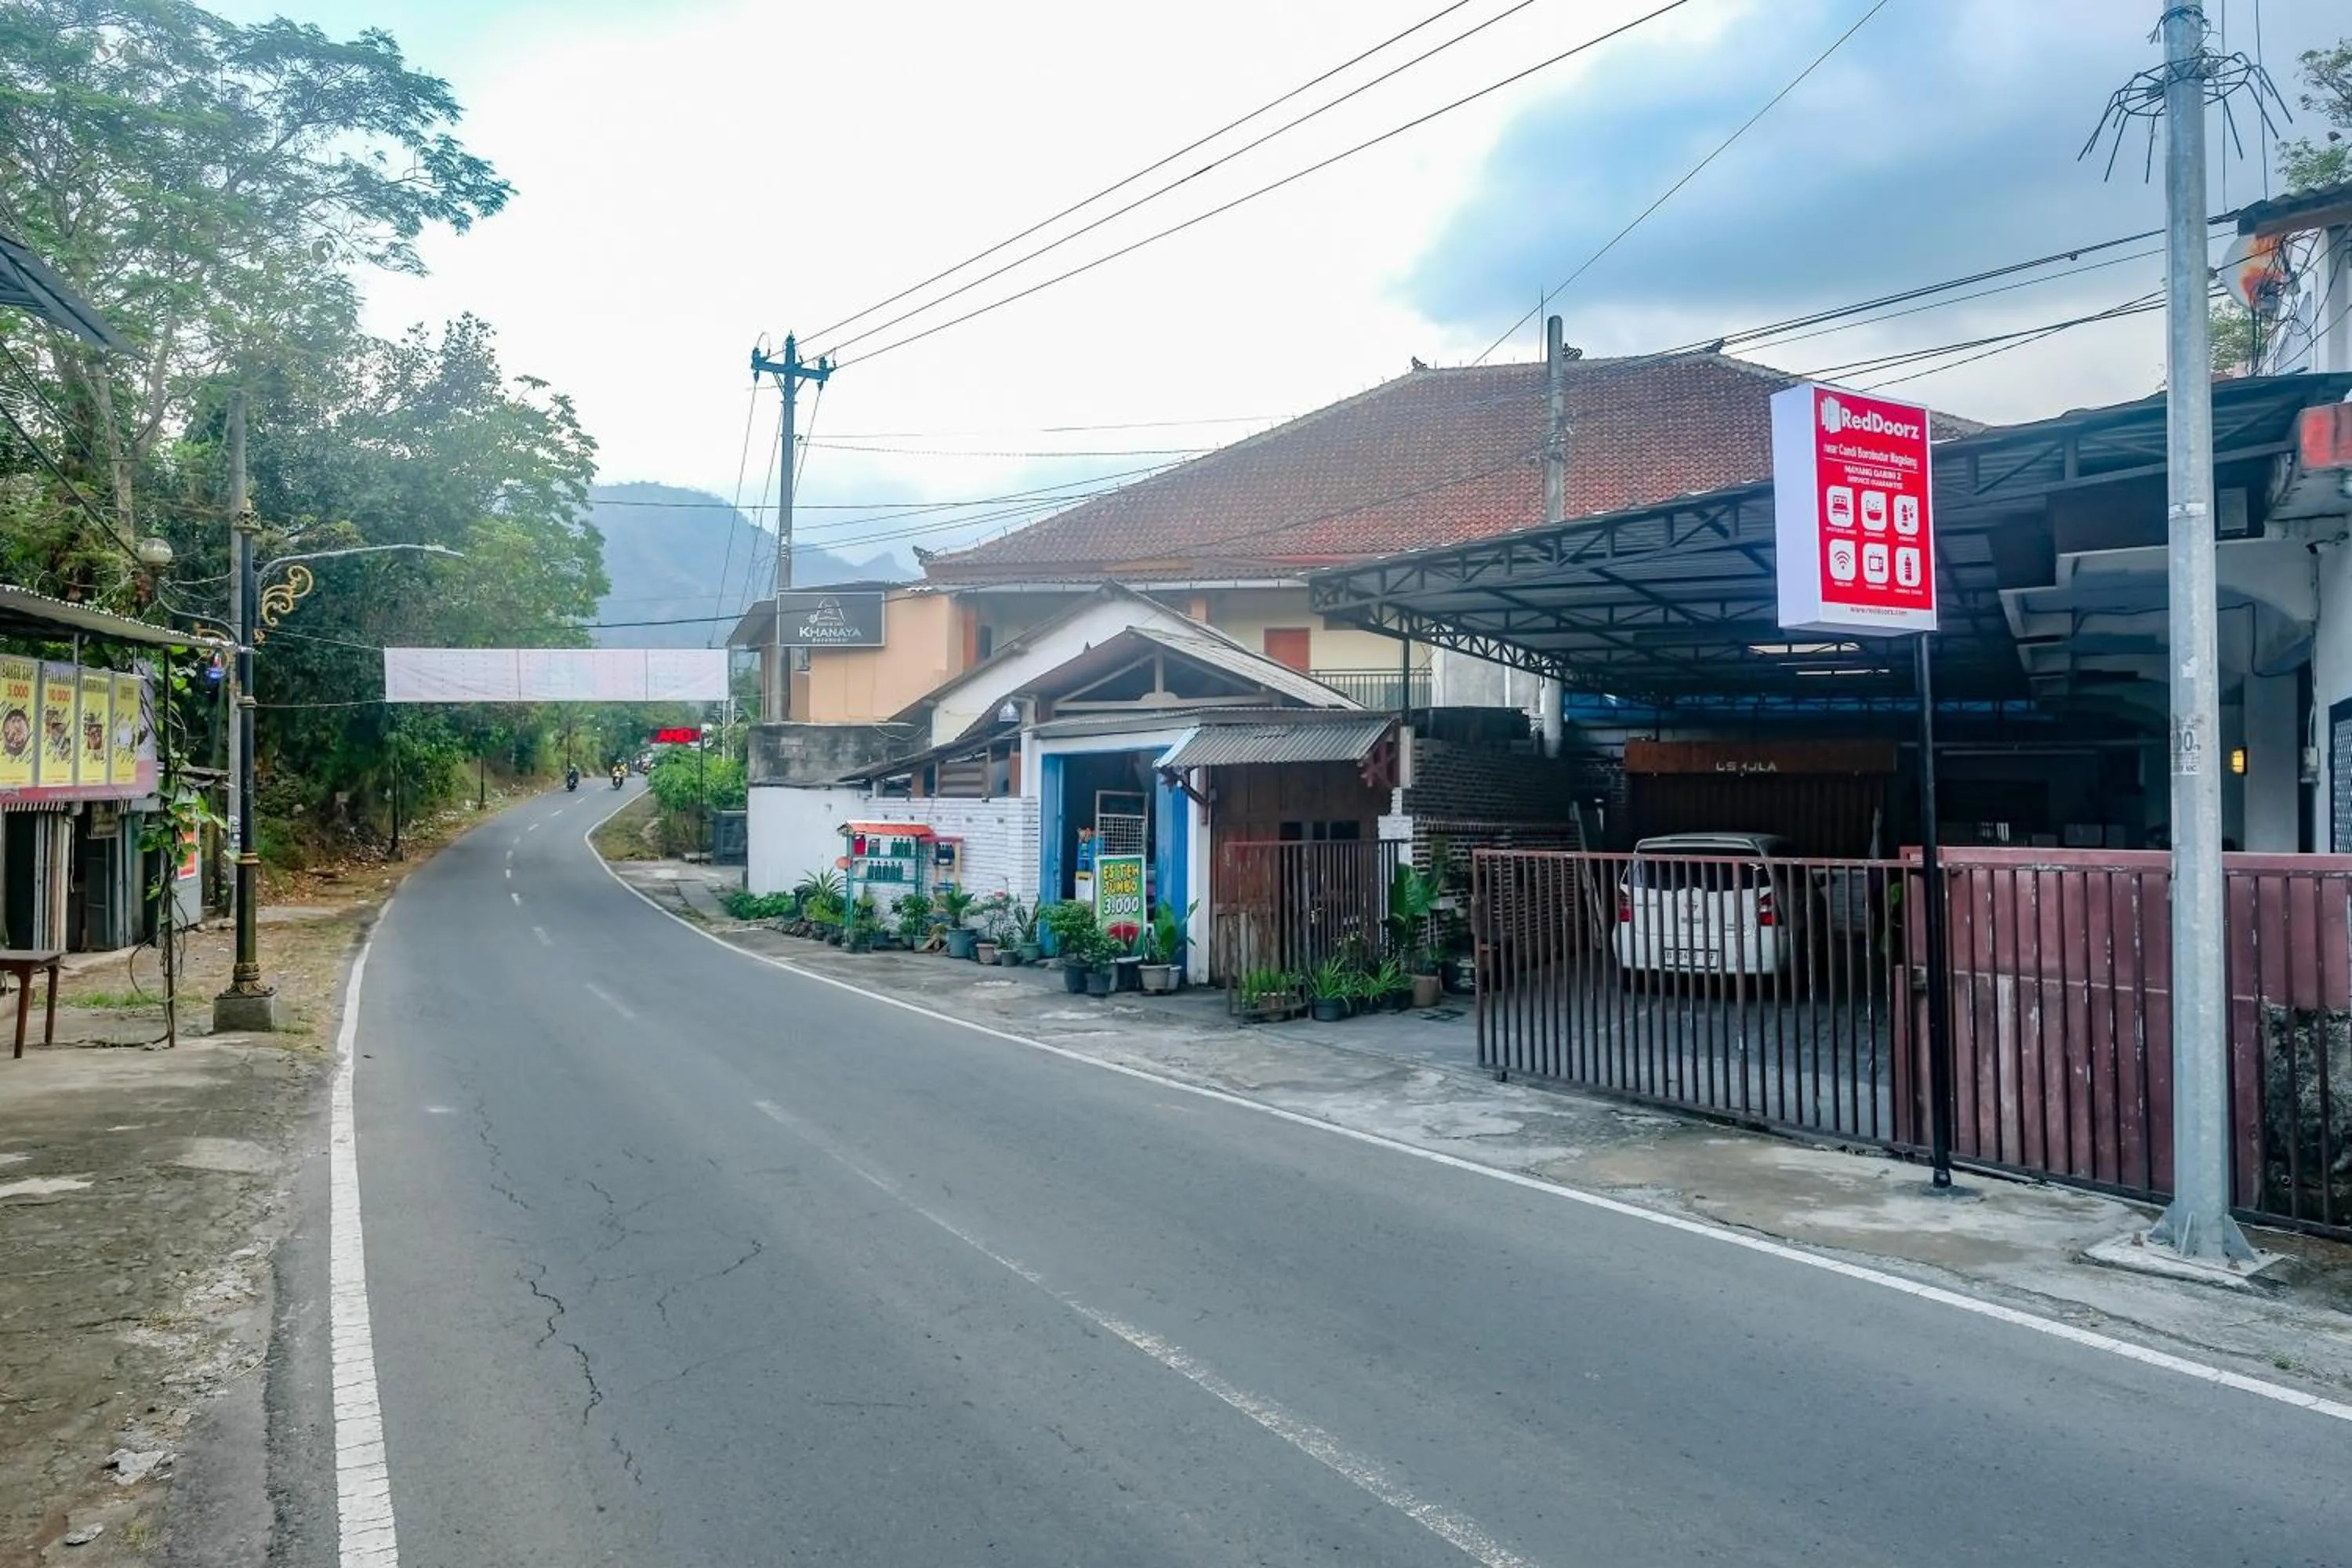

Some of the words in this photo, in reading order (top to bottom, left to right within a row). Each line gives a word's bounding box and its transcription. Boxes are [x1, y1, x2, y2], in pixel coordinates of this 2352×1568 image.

[1841, 407, 1920, 440] RedDoorz
[799, 626, 862, 638] KHANAYA
[1103, 895, 1140, 916] 3.000
